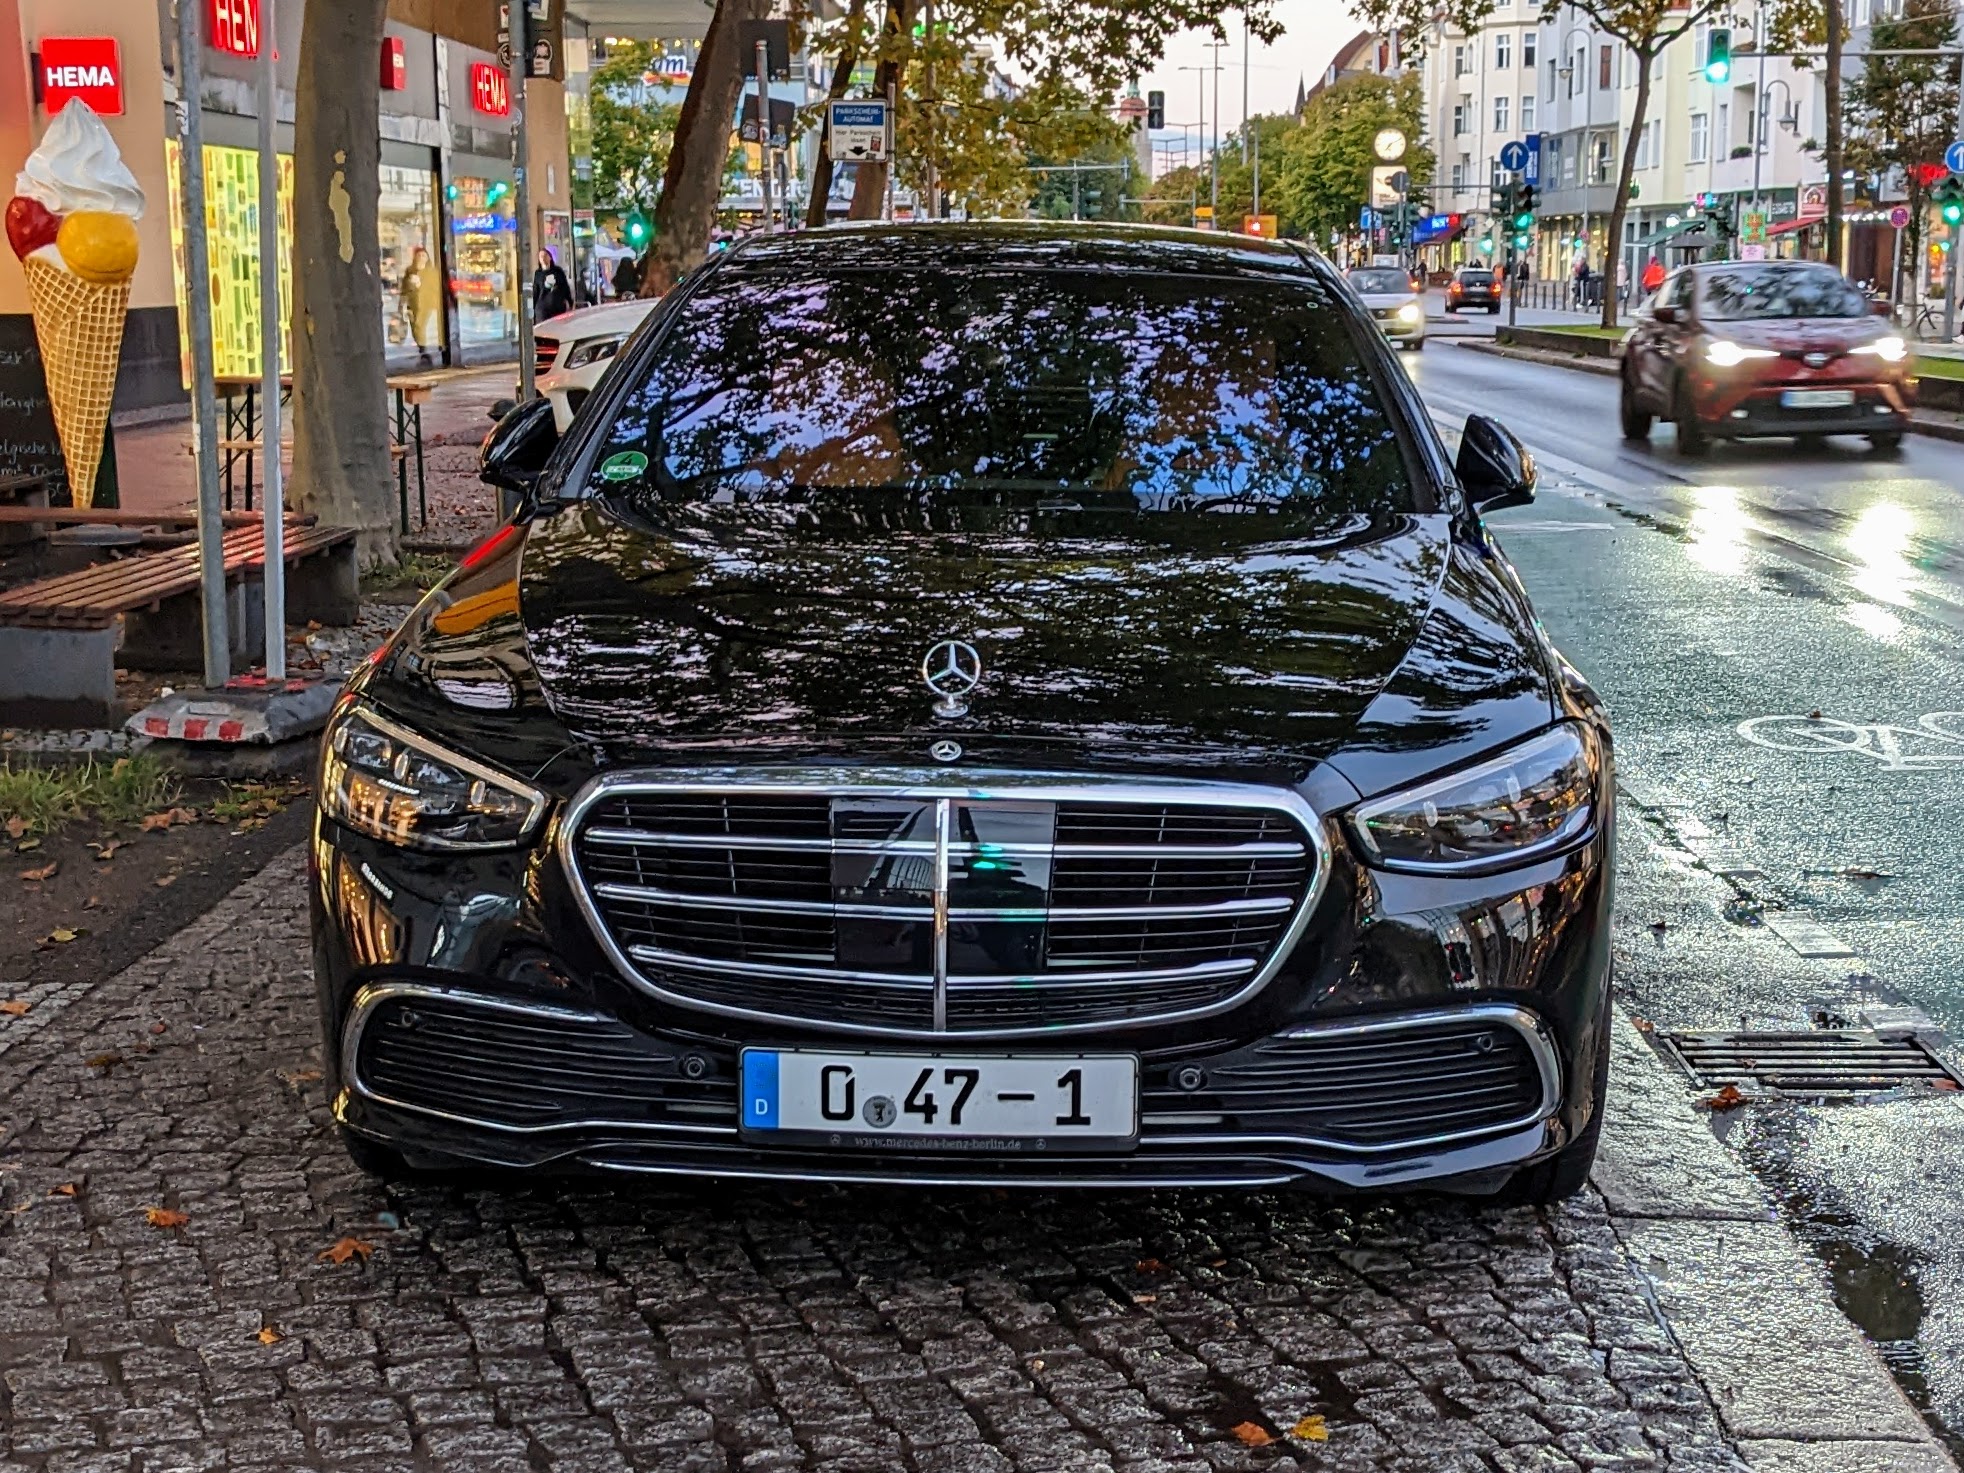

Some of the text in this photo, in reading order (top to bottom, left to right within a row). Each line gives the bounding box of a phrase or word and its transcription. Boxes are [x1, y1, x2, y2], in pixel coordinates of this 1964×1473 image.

[46, 66, 115, 87] HEMA
[476, 63, 509, 116] HEMA
[755, 1098, 769, 1116] D
[854, 1136, 1022, 1151] www.mercedes-benz-berlin.de
